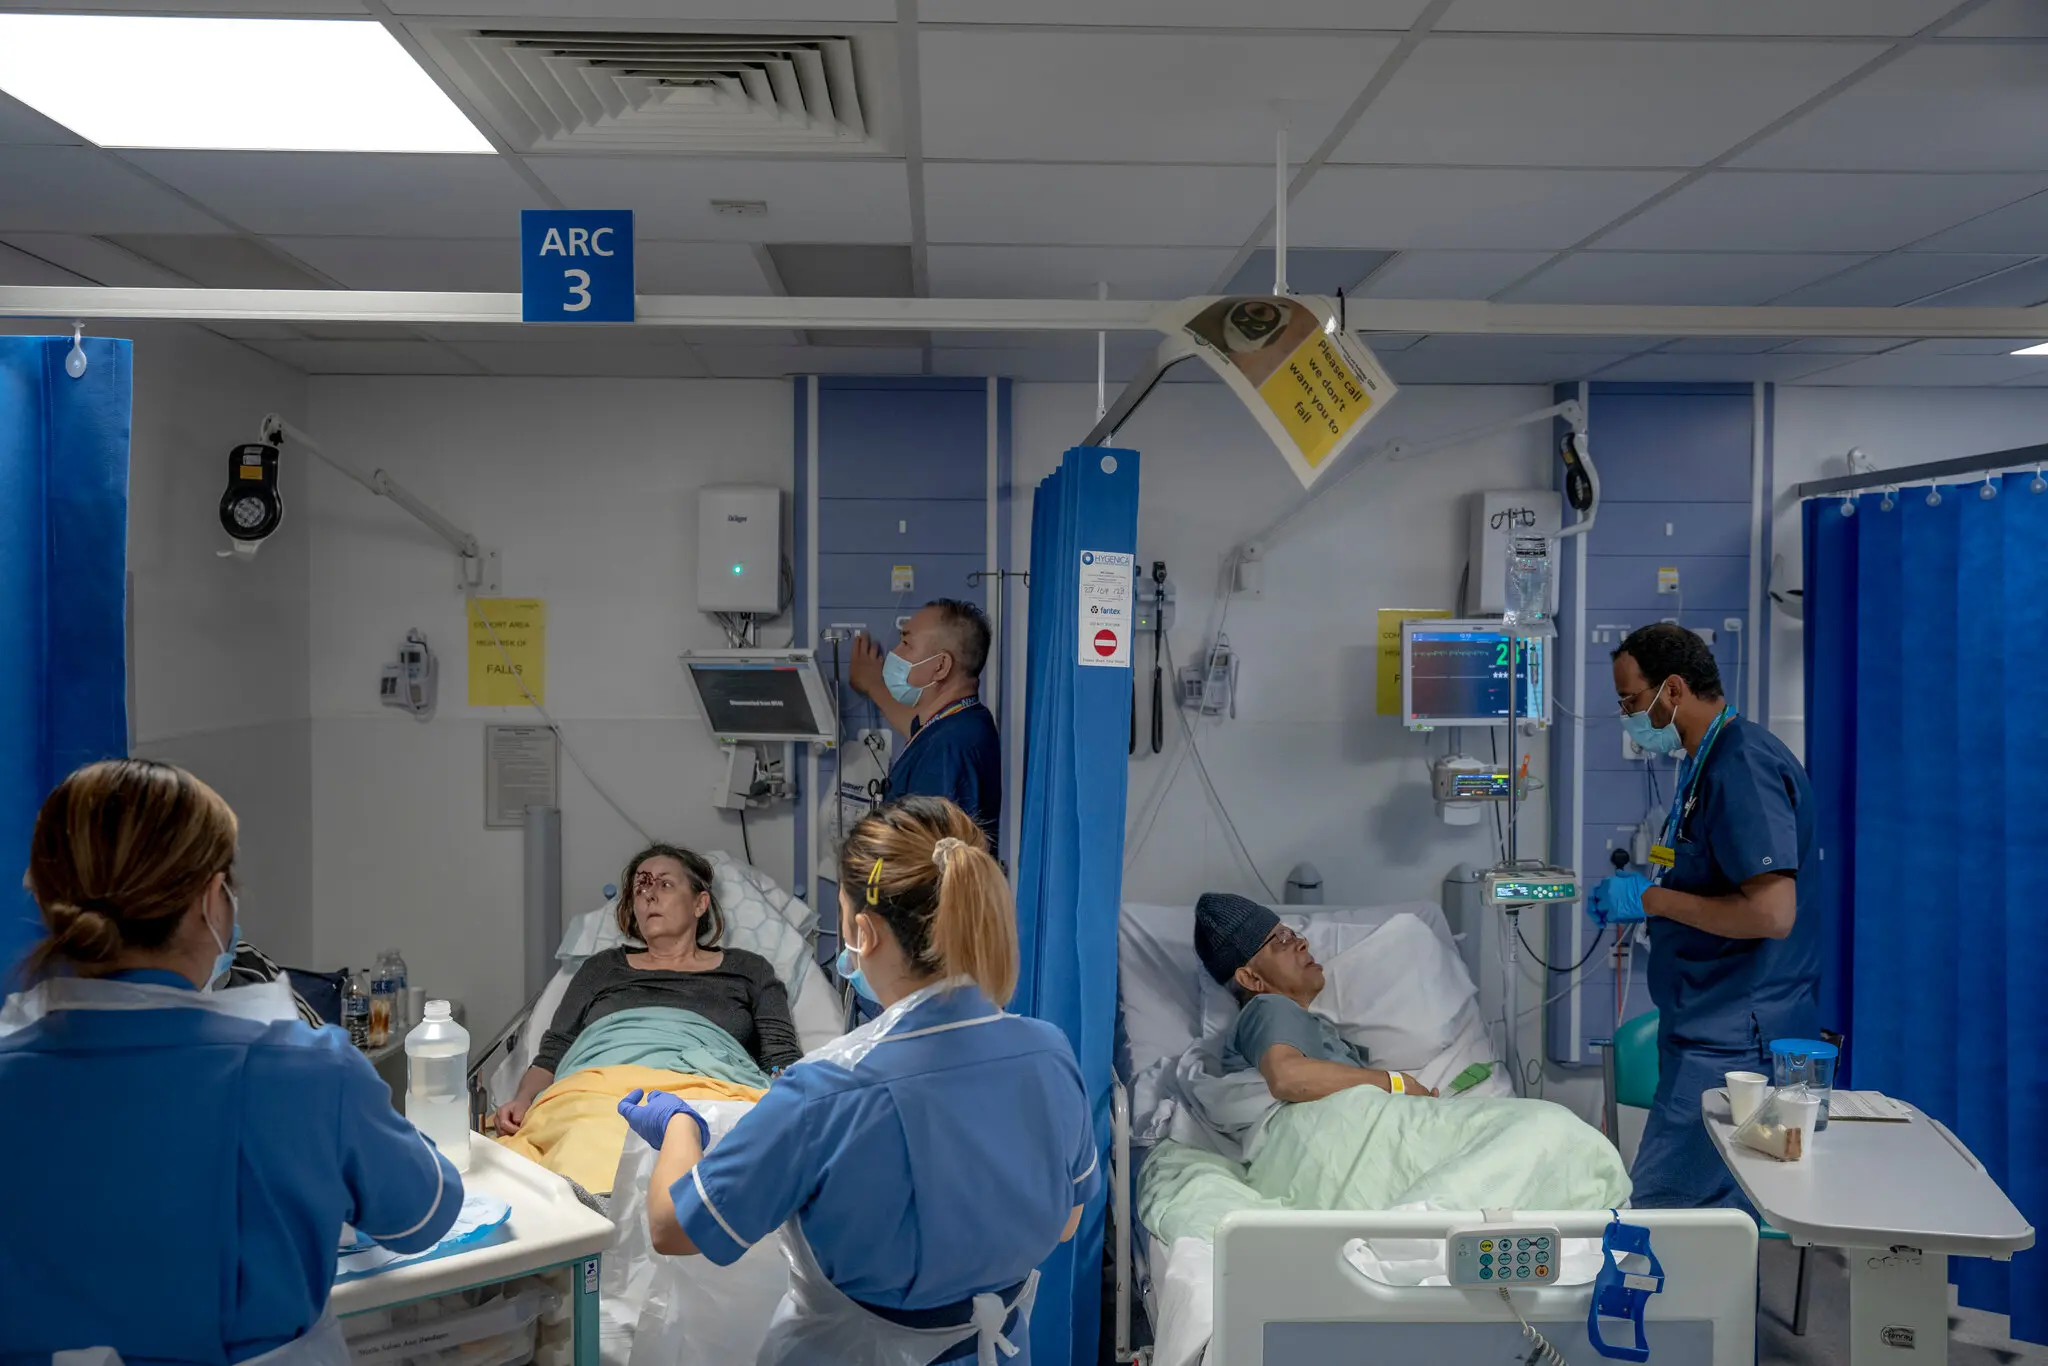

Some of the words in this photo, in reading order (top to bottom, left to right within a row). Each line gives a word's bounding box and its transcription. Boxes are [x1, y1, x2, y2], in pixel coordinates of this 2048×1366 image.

[539, 227, 614, 256] ARC
[563, 268, 592, 312] 3
[1308, 358, 1322, 379] we
[1321, 377, 1346, 413] don't
[1318, 339, 1345, 381] Please
[1344, 380, 1362, 403] call
[1289, 362, 1314, 396] want
[1311, 394, 1330, 420] you
[1327, 417, 1340, 435] to
[1294, 401, 1312, 424] fall
[1100, 606, 1121, 615] fantex
[486, 664, 523, 675] FALLS
